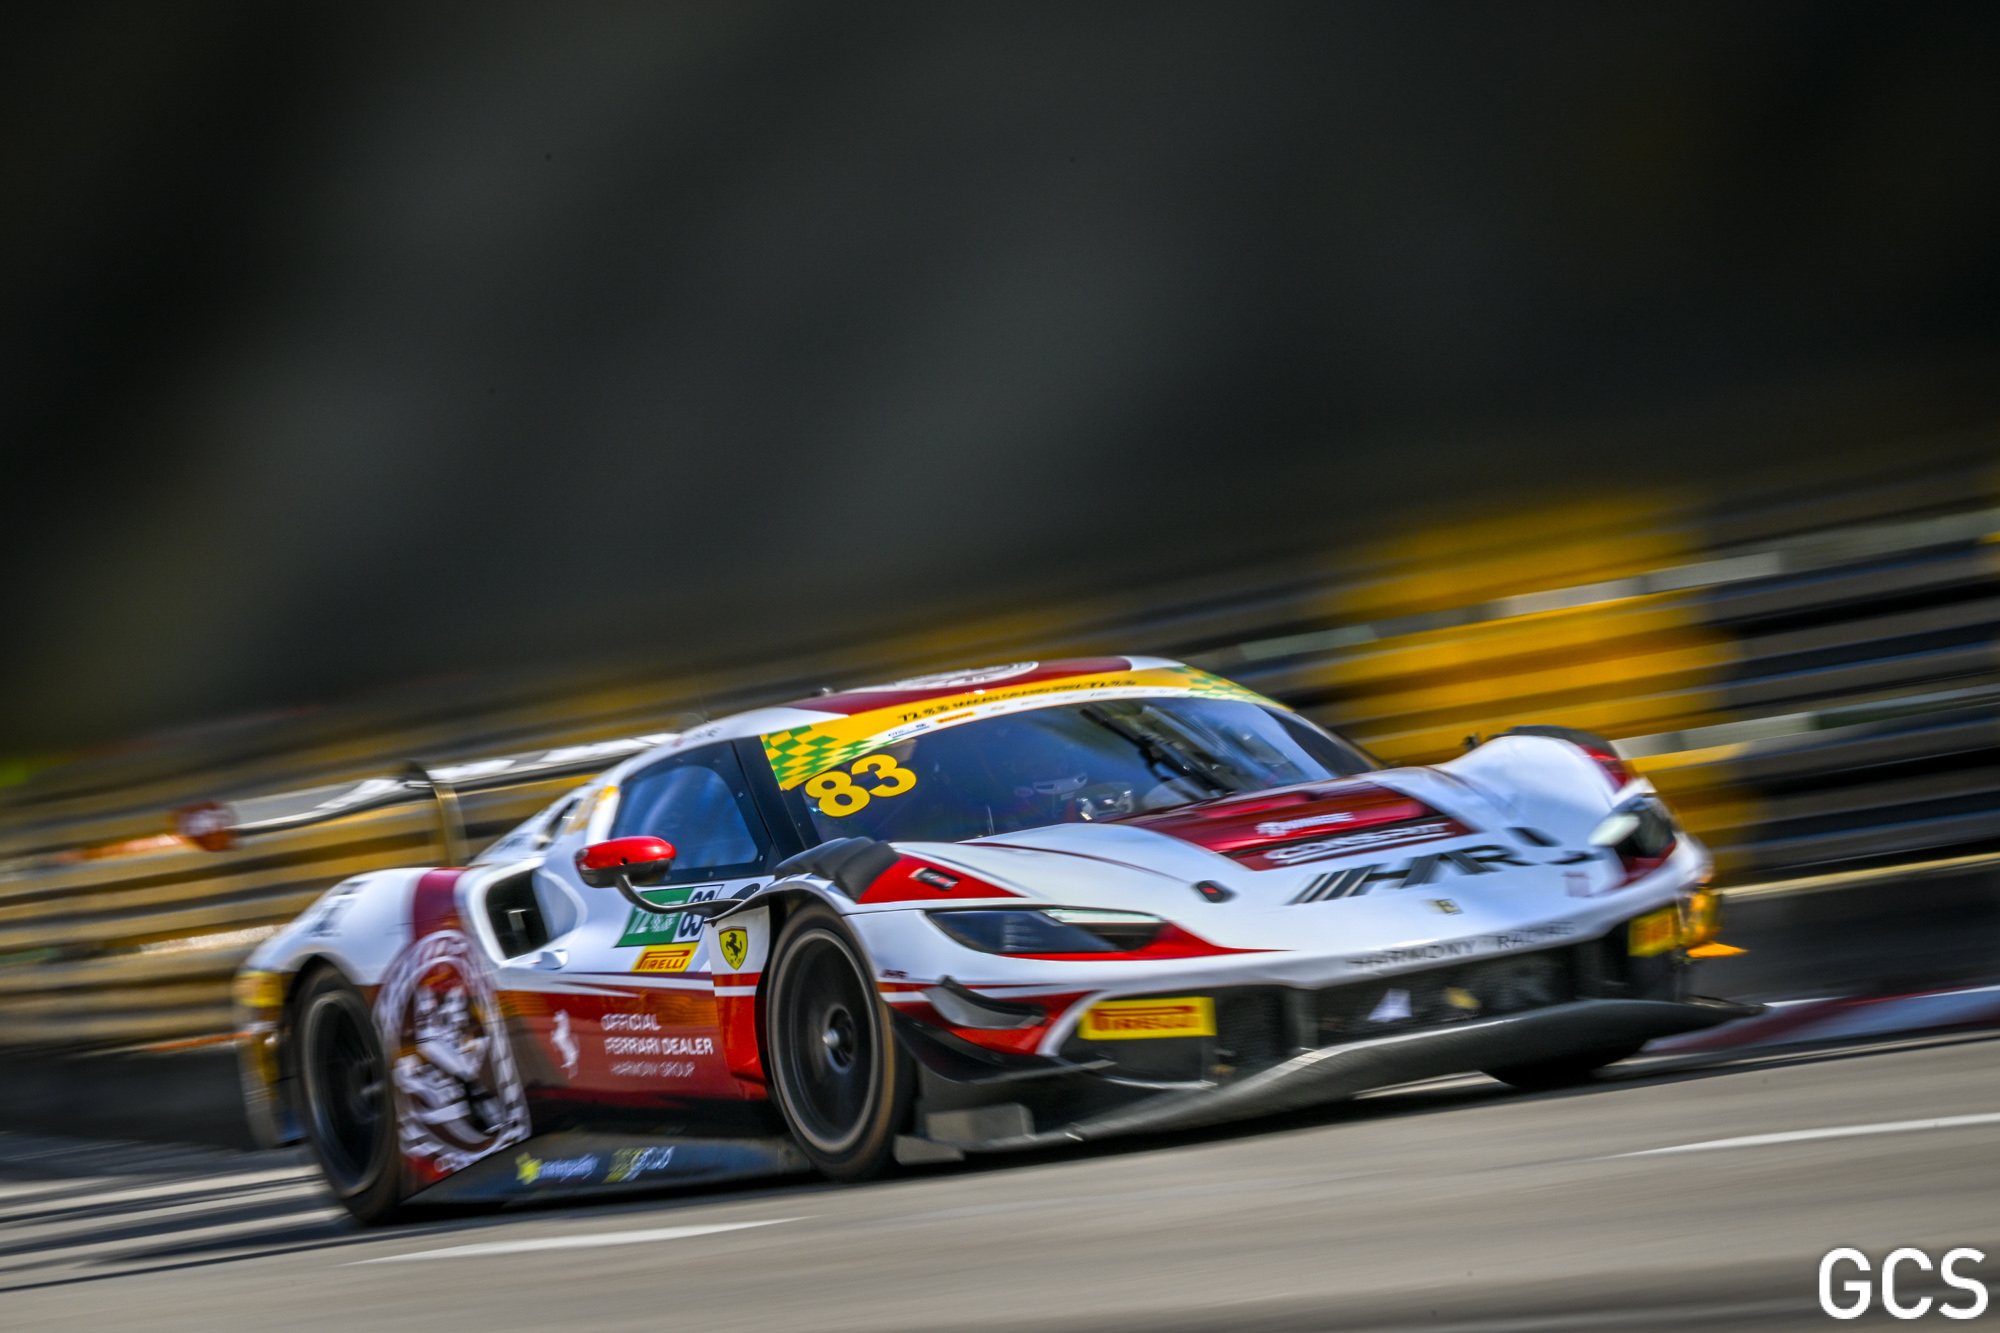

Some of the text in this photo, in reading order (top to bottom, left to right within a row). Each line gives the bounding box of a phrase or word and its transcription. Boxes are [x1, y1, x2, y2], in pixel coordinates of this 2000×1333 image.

[805, 754, 917, 817] 83
[635, 949, 691, 970] PIRELLI
[601, 1013, 661, 1031] OFFICIAL
[1089, 1005, 1200, 1031] PIRELLI
[604, 1037, 714, 1055] FERRARI DEALER
[659, 1060, 696, 1077] GROUP
